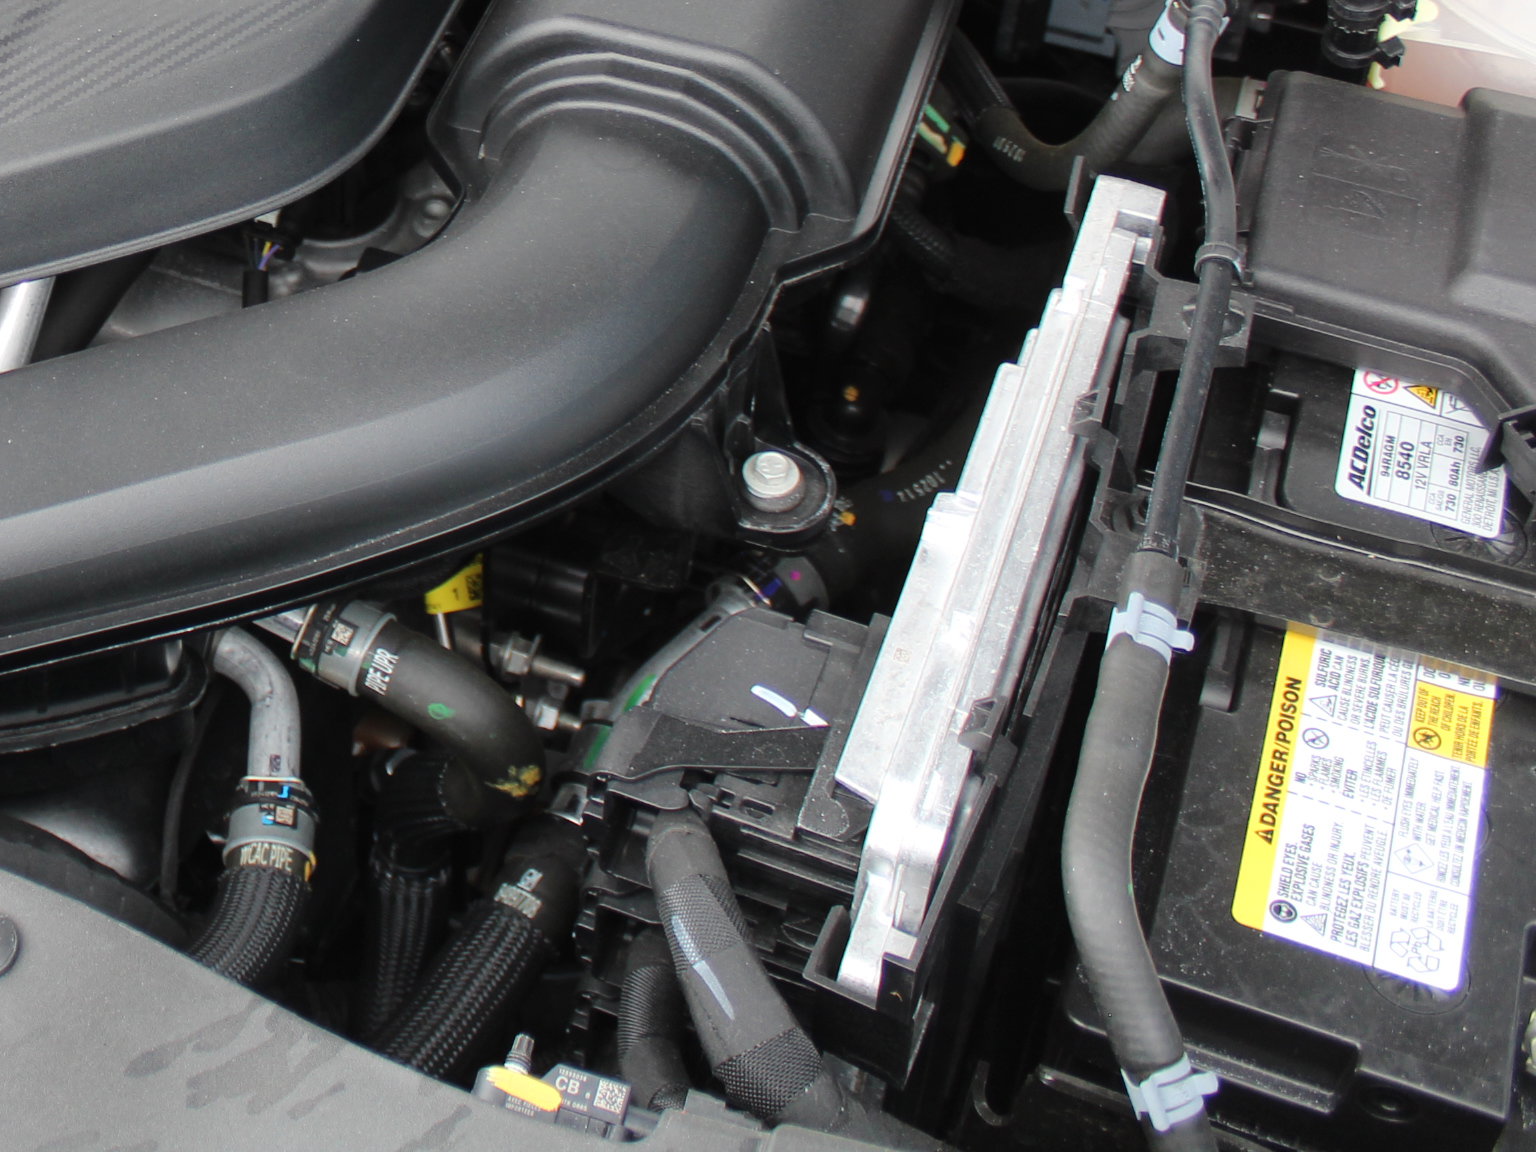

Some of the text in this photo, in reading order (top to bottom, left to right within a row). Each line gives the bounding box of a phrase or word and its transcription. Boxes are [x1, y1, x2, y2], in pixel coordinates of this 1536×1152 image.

[1348, 405, 1376, 489] ACDelco
[1380, 435, 1395, 477] 94RAGM
[1453, 435, 1465, 453] 730
[1395, 441, 1414, 480] 8540
[1415, 441, 1432, 490] 12V VRLA
[1448, 461, 1461, 486] 80Ah
[1466, 461, 1478, 491] MOTORS
[1445, 493, 1457, 512] 730
[1461, 493, 1474, 524] GENERAL
[365, 648, 400, 696] PIPE UPR
[1315, 648, 1332, 687] SULFURIC
[1328, 655, 1344, 691] ACID CAN
[1337, 655, 1358, 721] CAUSE BLINDNESS
[1352, 685, 1366, 713] SEVERE
[1379, 673, 1398, 733] PEUT CAUSER LA
[1350, 714, 1361, 725] OR
[1364, 700, 1378, 729] L'ACIDE
[1394, 710, 1406, 725] DES
[1427, 696, 1441, 726] THE REACH
[1457, 714, 1468, 723] DE
[1458, 705, 1469, 714] LA
[1392, 726, 1403, 737] OU
[1260, 677, 1301, 826] DANGER/POISON
[1295, 772, 1307, 783] NO
[1307, 755, 1322, 782] SPARKS
[1318, 757, 1333, 785] FLAMES
[1330, 756, 1344, 788] SMOKING
[1370, 751, 1387, 802] LES FLAMMES
[1359, 783, 1370, 798] LES
[1381, 767, 1396, 806] DE FUMER
[269, 842, 295, 872] PIPE
[1277, 843, 1297, 898] SHIELD EYES.
[1291, 824, 1315, 902] EXPLOSIVE GASES
[1327, 853, 1338, 865] OR
[1341, 853, 1355, 876] YEUX.
[1306, 862, 1323, 906] CAN CAUSE
[1319, 866, 1336, 911] BLINDNESS
[1338, 878, 1352, 895] LES
[1345, 824, 1374, 948] LES GAZ EXPLOSIFS PEUVENT
[1367, 868, 1382, 900] RENDRE
[1365, 901, 1377, 913] OU
[1359, 914, 1374, 952] BLESSER
[555, 1076, 580, 1095] CB
